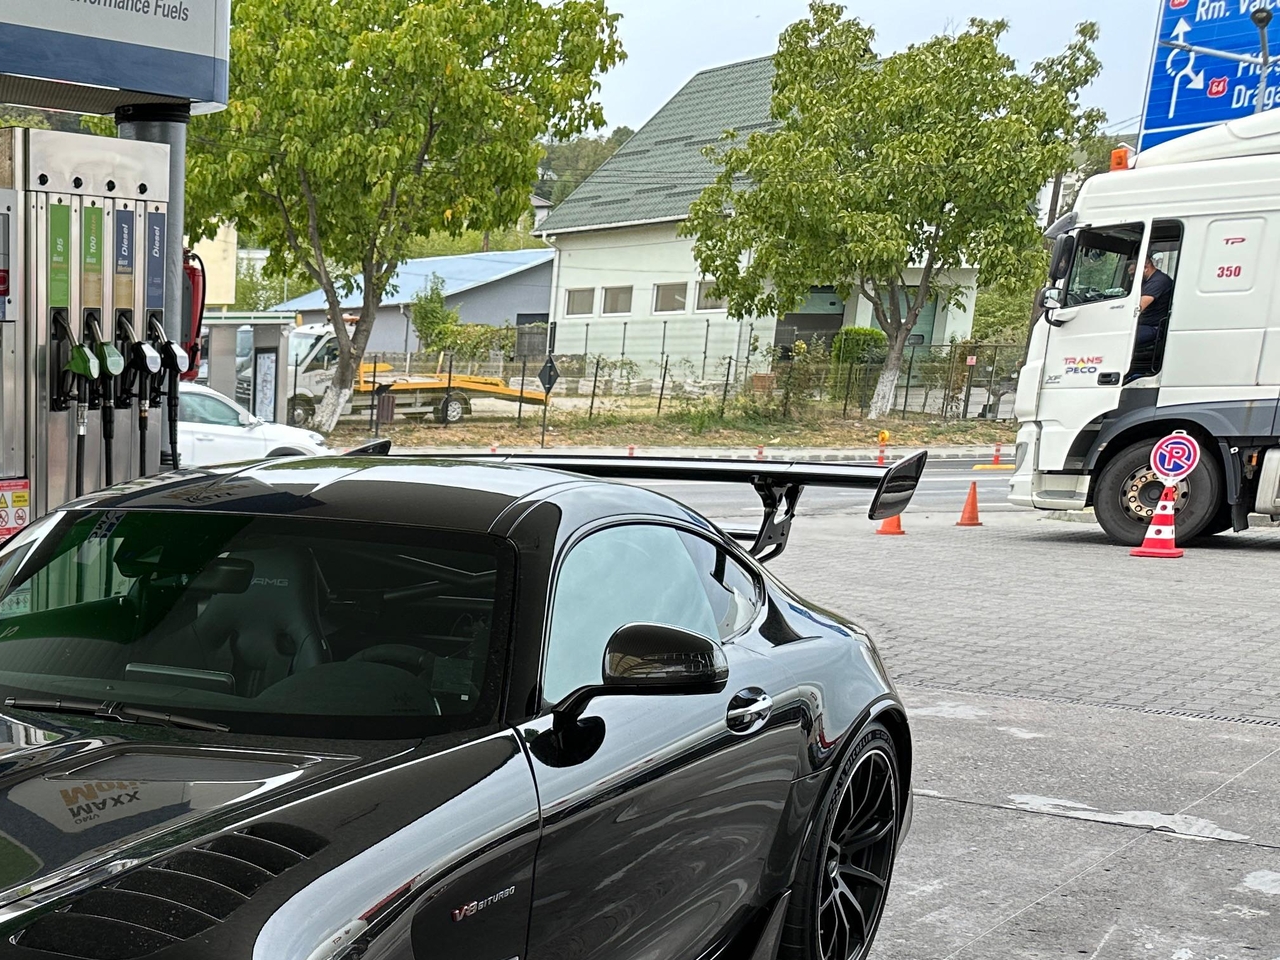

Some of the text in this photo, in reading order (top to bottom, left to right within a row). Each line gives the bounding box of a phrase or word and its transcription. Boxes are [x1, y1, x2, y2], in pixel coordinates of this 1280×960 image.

[153, 0, 189, 21] Fuels
[56, 237, 64, 253] 95
[152, 226, 160, 258] Diesel
[1217, 265, 1242, 278] 350
[1063, 356, 1104, 366] TRANS
[1065, 366, 1098, 375] PECO
[251, 578, 289, 587] AMG
[451, 885, 516, 922] V8 BITURBO
